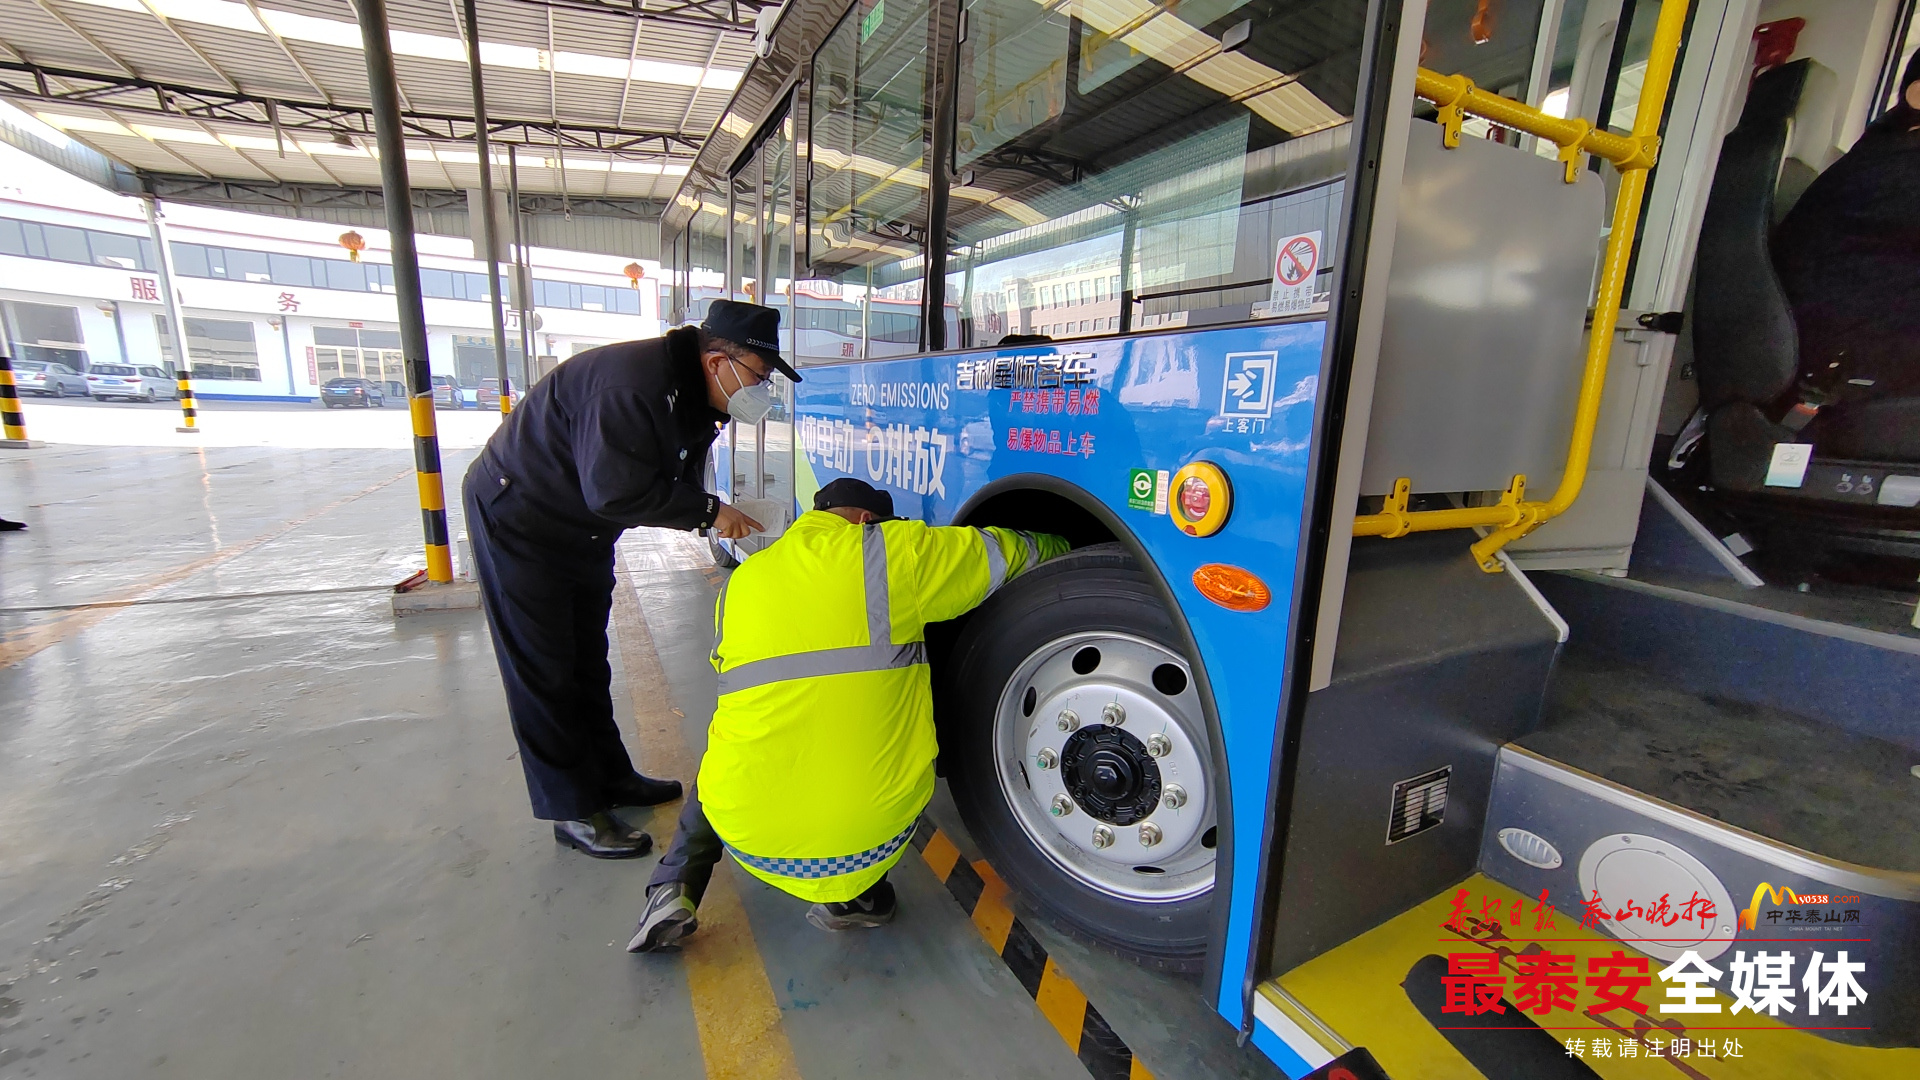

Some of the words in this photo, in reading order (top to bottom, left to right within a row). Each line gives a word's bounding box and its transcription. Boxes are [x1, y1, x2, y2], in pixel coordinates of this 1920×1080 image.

[130, 276, 159, 301] 服
[277, 291, 301, 312] 务
[1273, 285, 1312, 301] 禁止携带
[956, 352, 1097, 390] 吉利星际客车
[851, 383, 876, 406] ZERO
[880, 382, 950, 410] EMISSIONS
[1008, 388, 1100, 415] 严禁携带易燃
[1222, 417, 1265, 434] 上客门
[801, 414, 854, 474] 纯电动
[1007, 427, 1096, 459] 易爆物品上车
